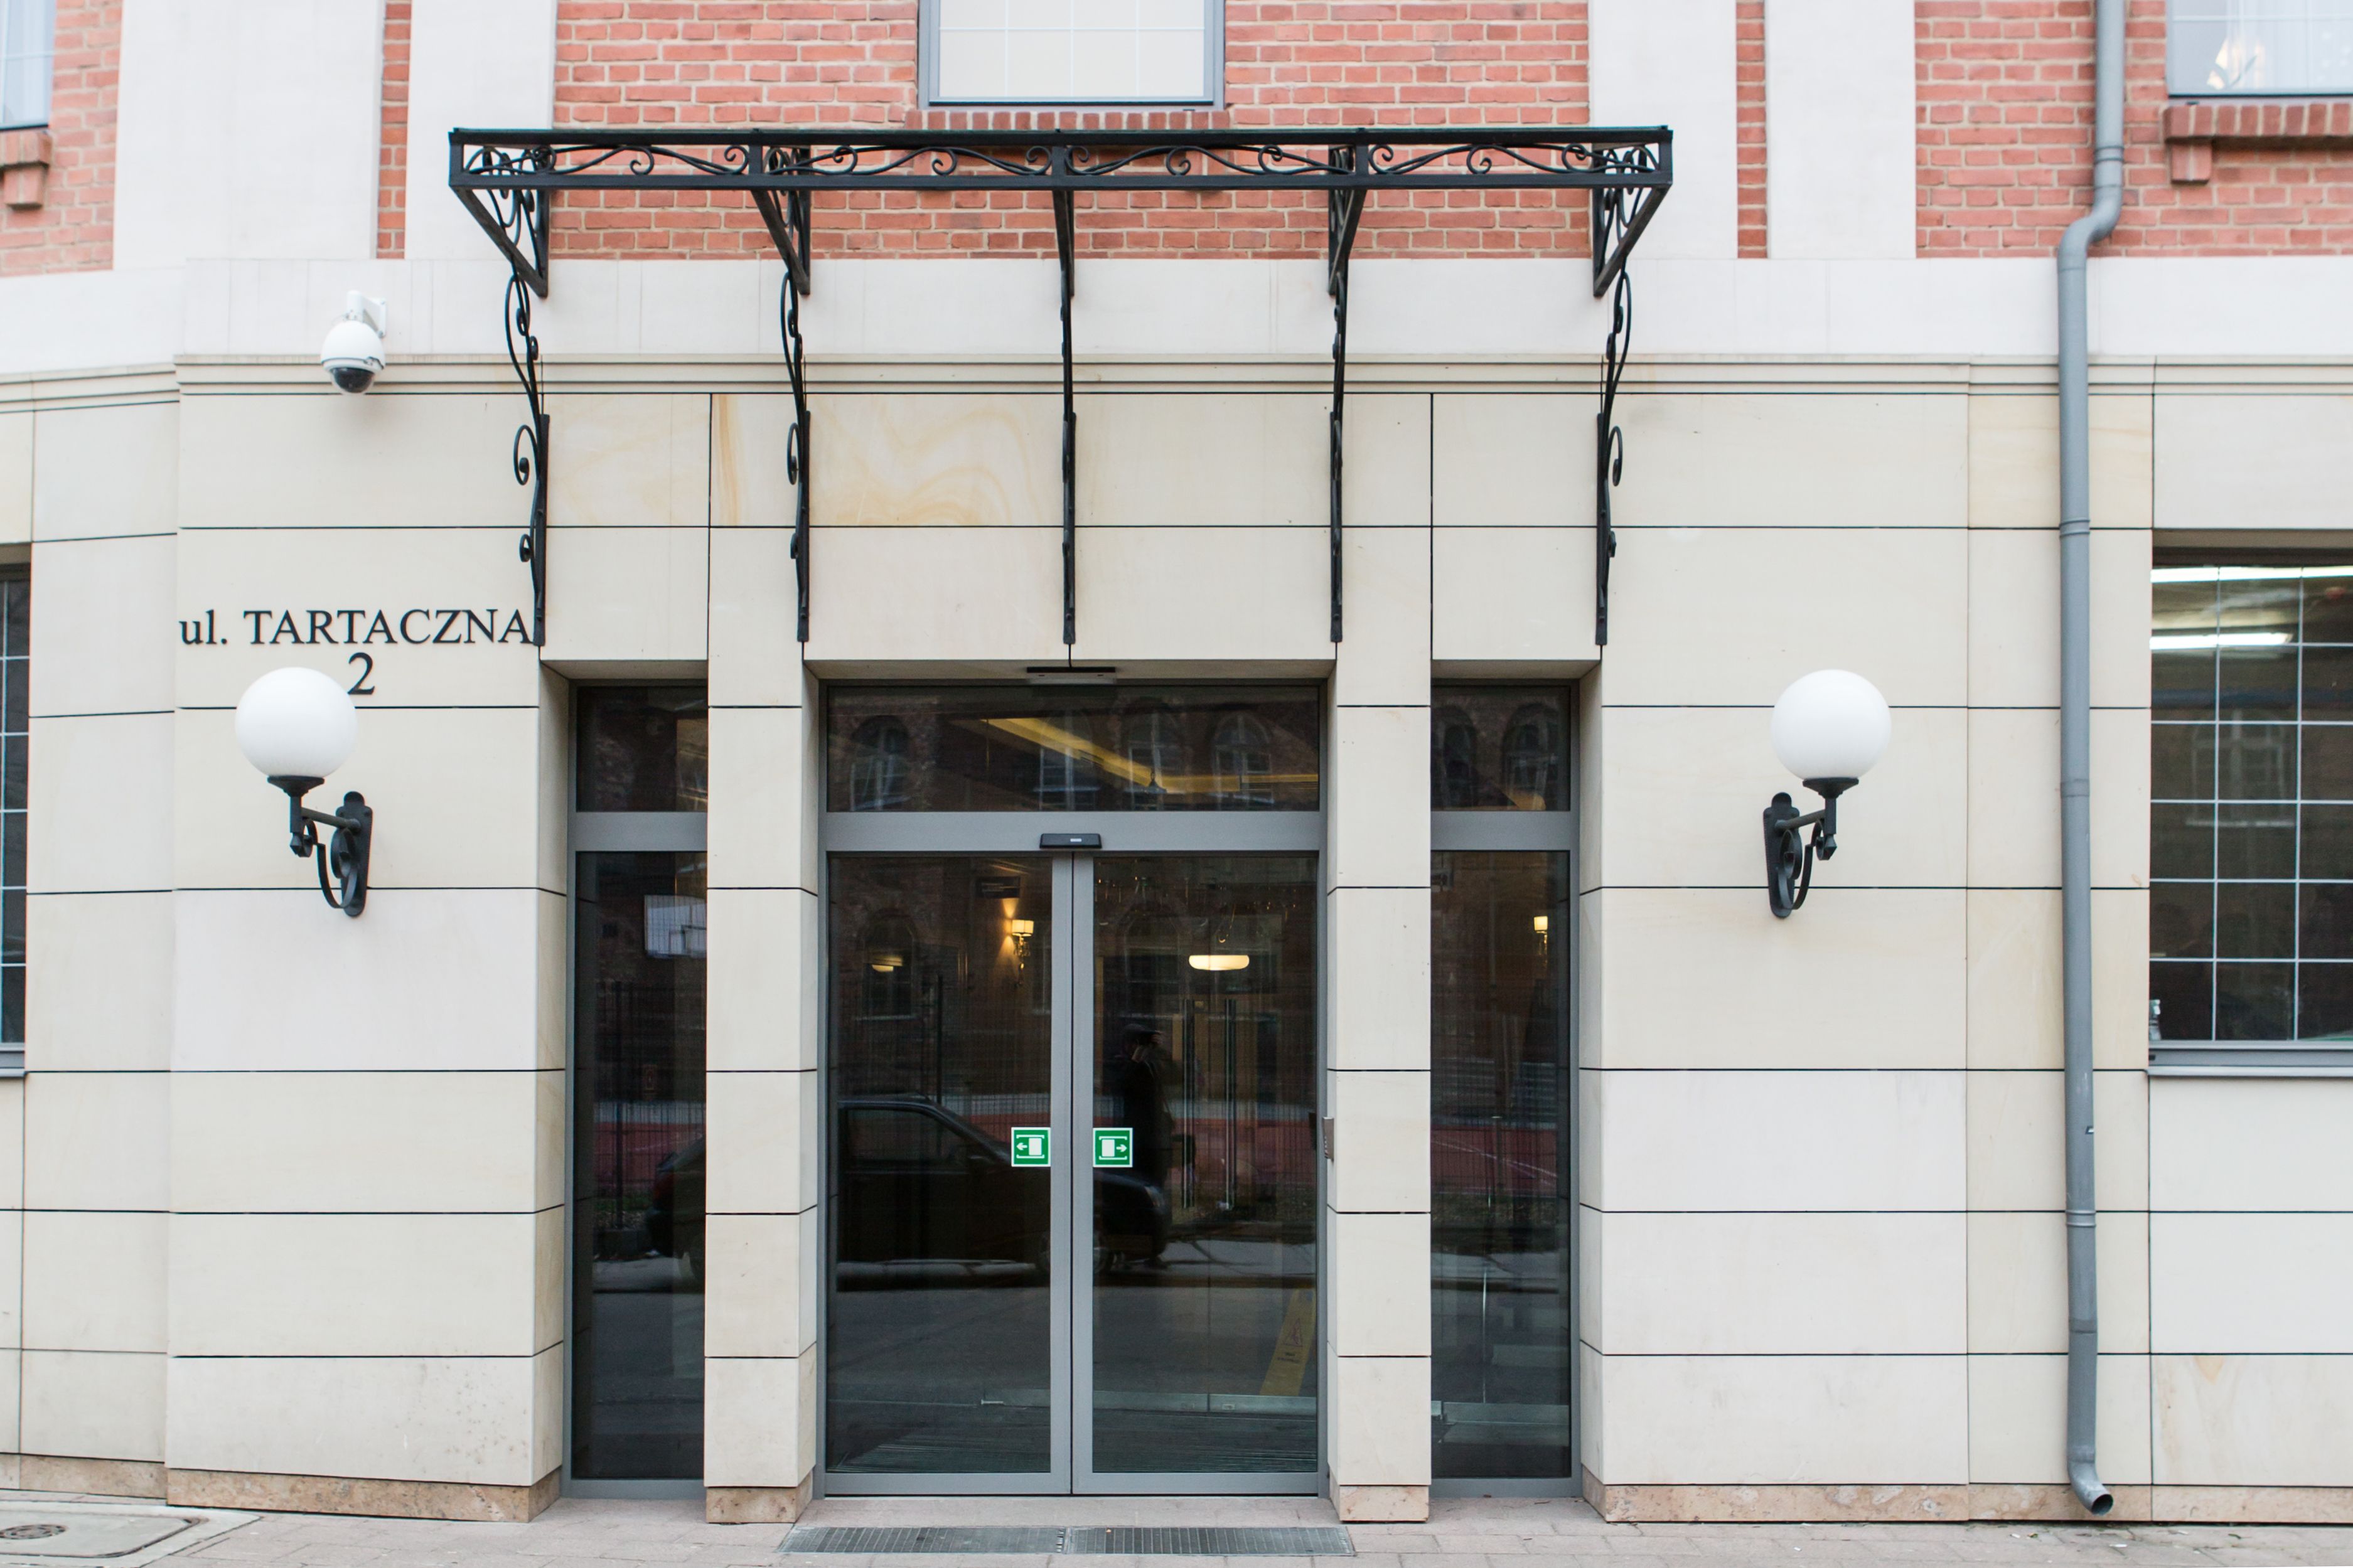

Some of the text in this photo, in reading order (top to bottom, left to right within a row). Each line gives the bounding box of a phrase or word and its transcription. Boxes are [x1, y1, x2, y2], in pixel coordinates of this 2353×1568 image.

[179, 609, 533, 644] ul. TARTACZNA
[347, 652, 375, 695] 2
